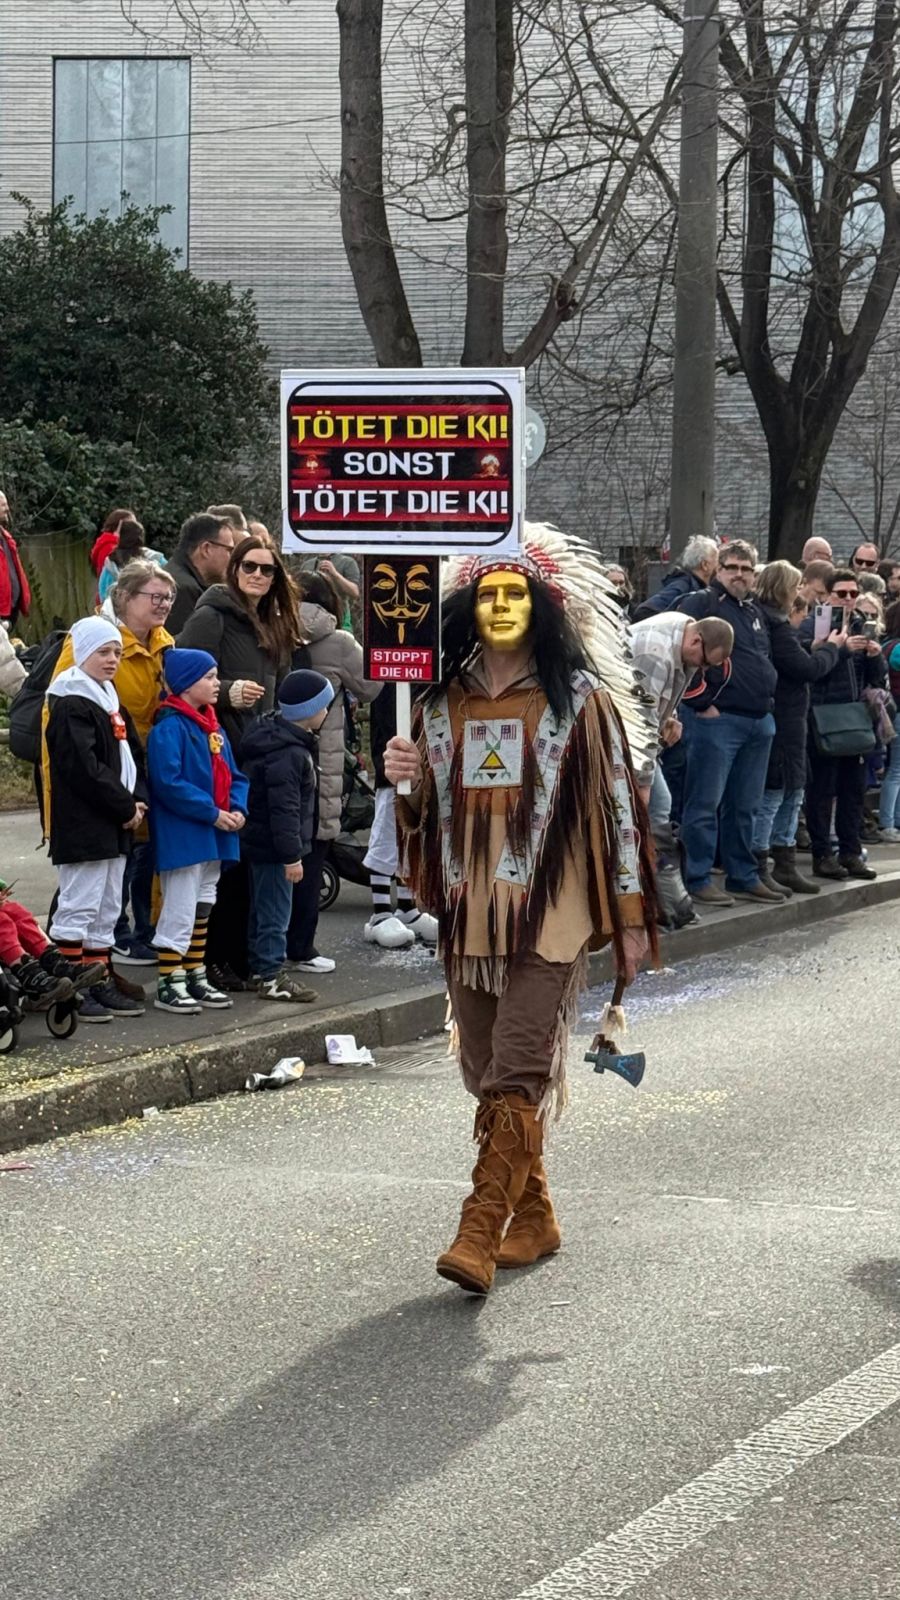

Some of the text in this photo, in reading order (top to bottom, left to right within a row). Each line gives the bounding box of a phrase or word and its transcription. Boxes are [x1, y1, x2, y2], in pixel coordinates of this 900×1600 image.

[292, 410, 508, 444] TÖTET DIE KI!
[343, 450, 456, 481] SONST
[293, 484, 508, 518] TÖTET DIE KI!
[373, 651, 429, 664] STOPPT
[379, 667, 402, 677] DIE
